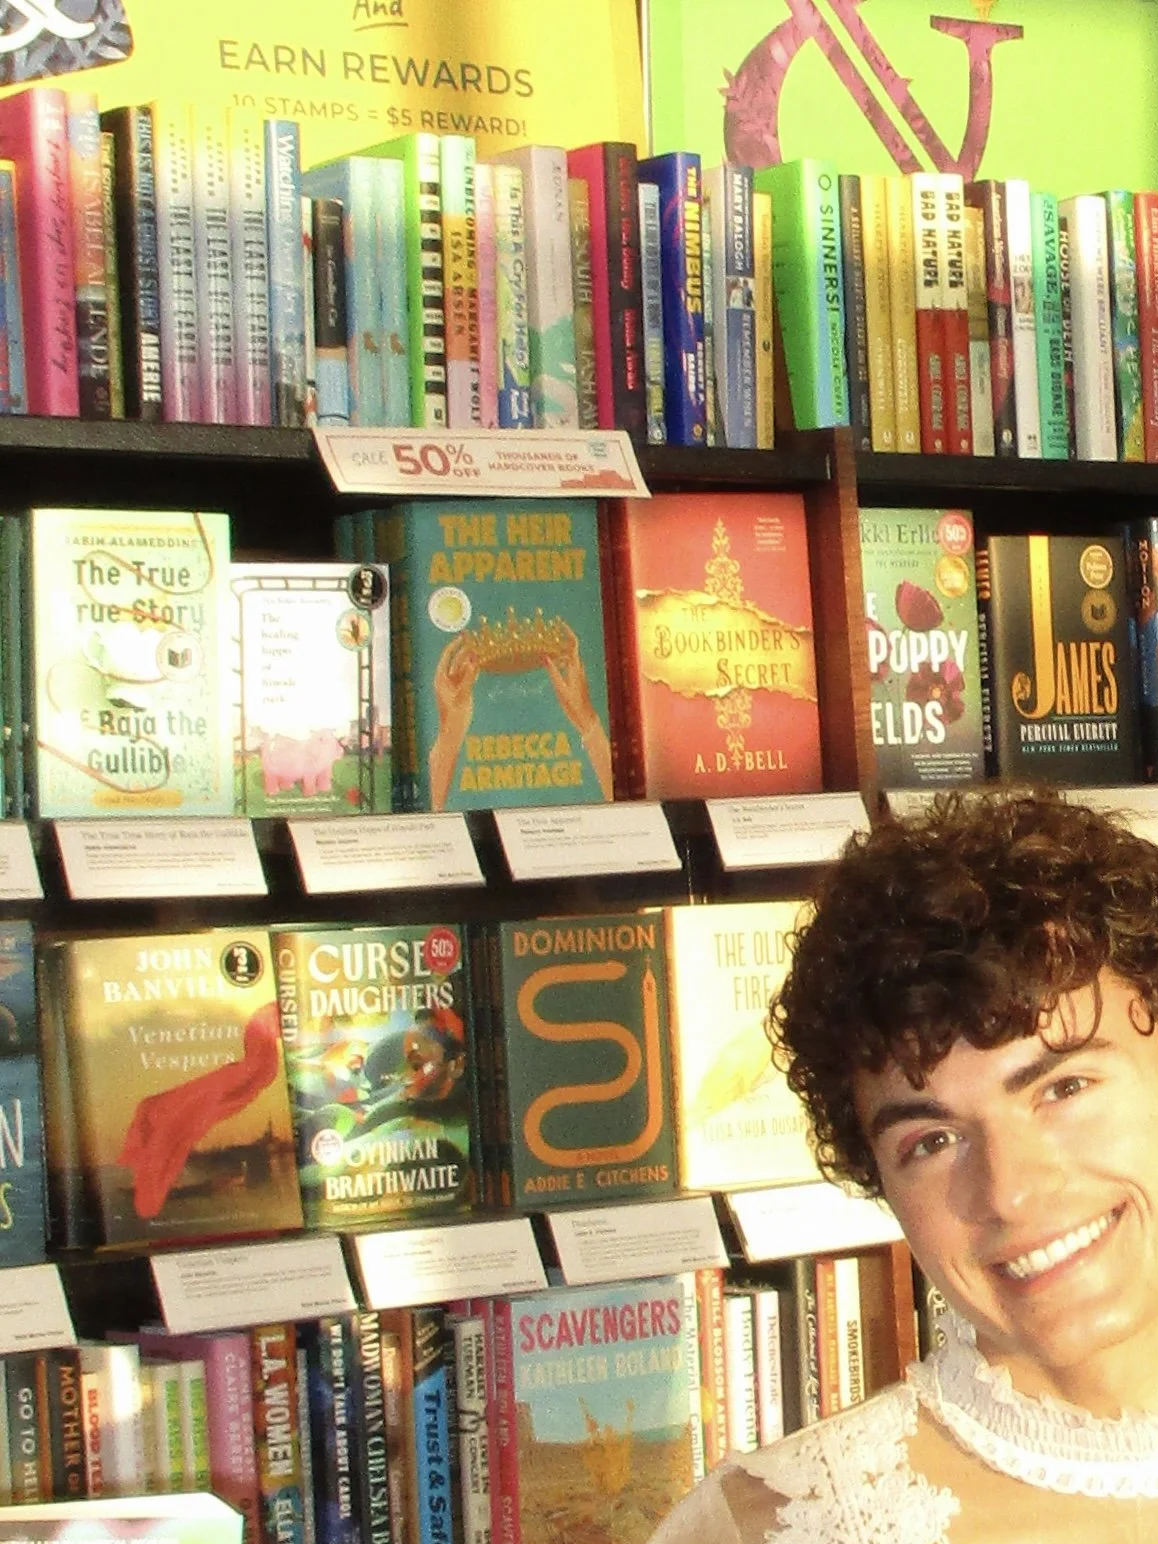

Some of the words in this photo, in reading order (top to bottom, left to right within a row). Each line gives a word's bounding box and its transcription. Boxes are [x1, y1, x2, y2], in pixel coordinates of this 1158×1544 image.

[219, 40, 326, 77] EARN
[344, 52, 534, 98] REWARDS
[266, 97, 359, 121] STAMPS
[421, 111, 527, 137] REWARD!
[686, 166, 696, 197] THE
[684, 200, 701, 314] NIMBUS
[820, 204, 840, 313] SINNERS!
[439, 513, 497, 548] THE
[507, 513, 572, 545] HEIR
[73, 559, 121, 585] The
[132, 560, 191, 587] True
[428, 550, 586, 584] APPARENT
[1010, 535, 1118, 720] JAMES
[868, 630, 969, 674] POPPY
[716, 657, 793, 689] SECRET
[99, 711, 157, 739] Raja
[167, 712, 208, 736] the
[1020, 723, 1072, 742] PERCIVAL
[1074, 722, 1118, 741] EVERETT
[466, 732, 571, 761] REBECCA
[459, 761, 583, 792] ARMITAGE
[513, 924, 657, 957] DOMINION
[714, 931, 747, 968] THE
[753, 929, 787, 964] OLD
[310, 982, 454, 1017] DAUGHTERS
[732, 975, 772, 1012] FIRE
[325, 1164, 459, 1200] BRAITHWAITE
[517, 1299, 681, 1354] SCAVENGERS
[260, 1335, 285, 1379] L.A.
[357, 1312, 383, 1433] MADWOMAN
[847, 1320, 861, 1404] SMOKEBIRDS
[264, 1384, 293, 1475] WOMEN
[424, 1388, 444, 1466] Trust
[366, 1436, 391, 1526] CHELSEA
[427, 1470, 443, 1490] &
